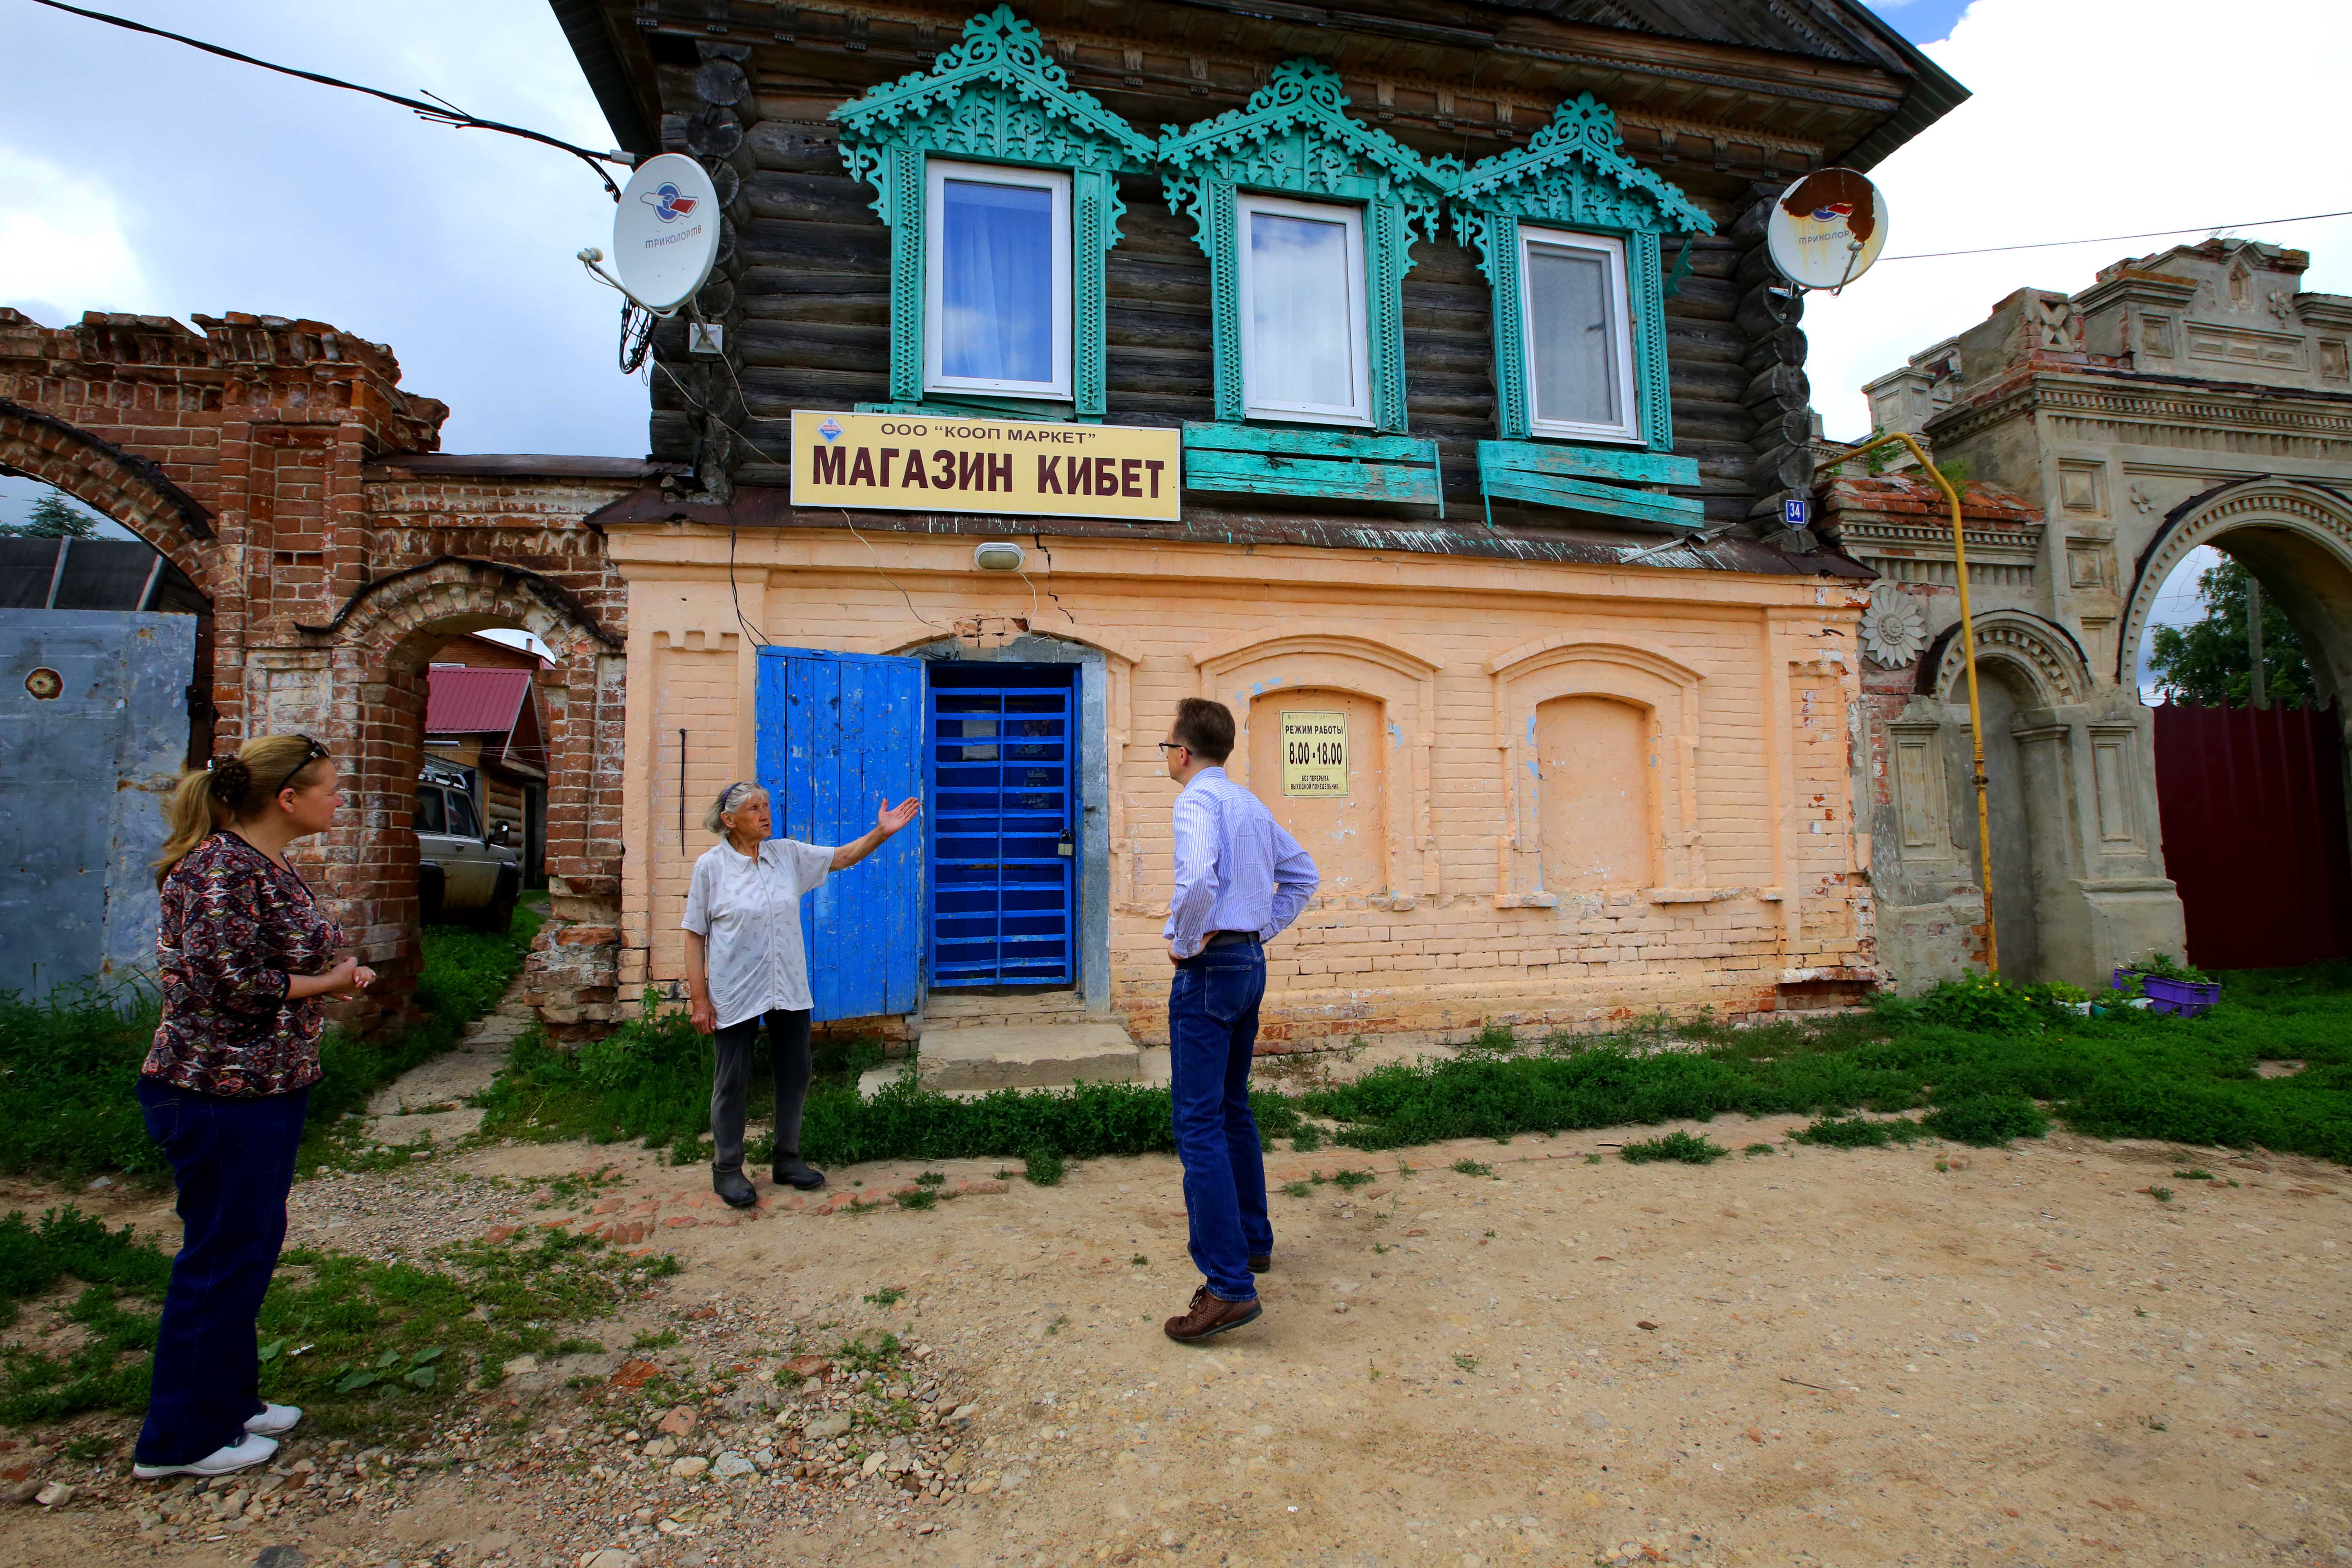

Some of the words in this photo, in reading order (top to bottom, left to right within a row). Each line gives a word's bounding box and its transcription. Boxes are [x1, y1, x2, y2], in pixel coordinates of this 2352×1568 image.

[881, 423, 927, 436] ООО
[813, 445, 1012, 492] МАГАЗИН
[1037, 454, 1165, 498] КИБЕТ
[1790, 502, 1800, 518] 34
[1285, 725, 1312, 734] РЕЖИМ
[1315, 725, 1343, 734] РАБОТЫ
